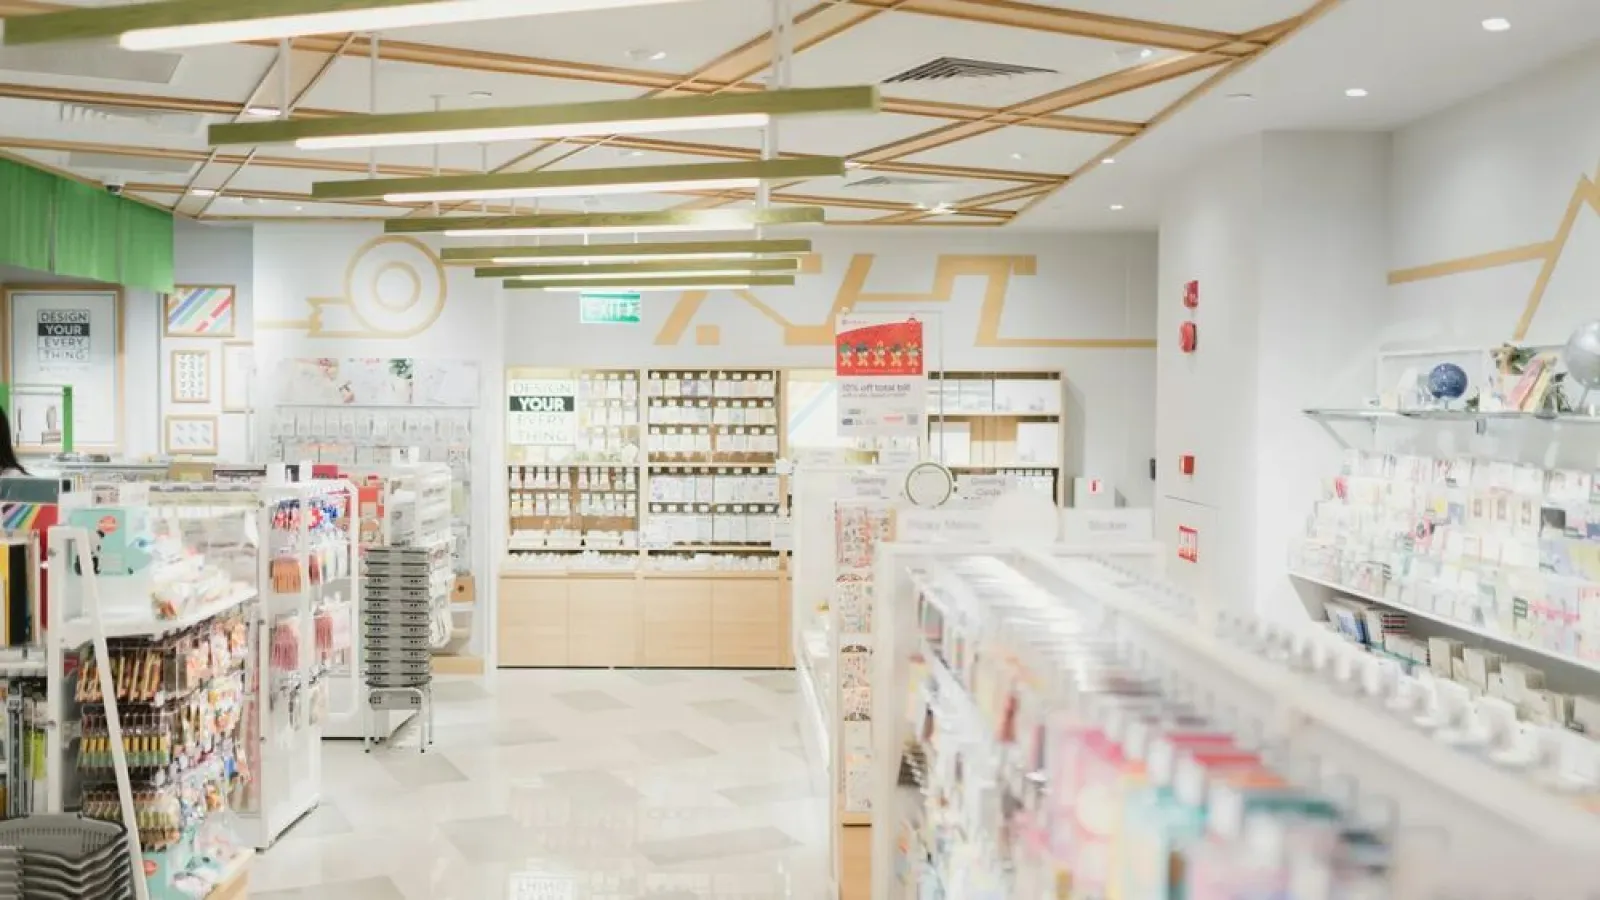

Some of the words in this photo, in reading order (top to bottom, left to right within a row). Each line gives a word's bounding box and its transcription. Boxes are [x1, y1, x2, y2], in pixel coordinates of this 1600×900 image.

[41, 312, 87, 321] DESIGN
[45, 325, 81, 335] YOUR
[44, 338, 83, 347] EVERY
[513, 383, 571, 393] DESIGN
[875, 383, 895, 391] total
[519, 397, 565, 410] YOUR
